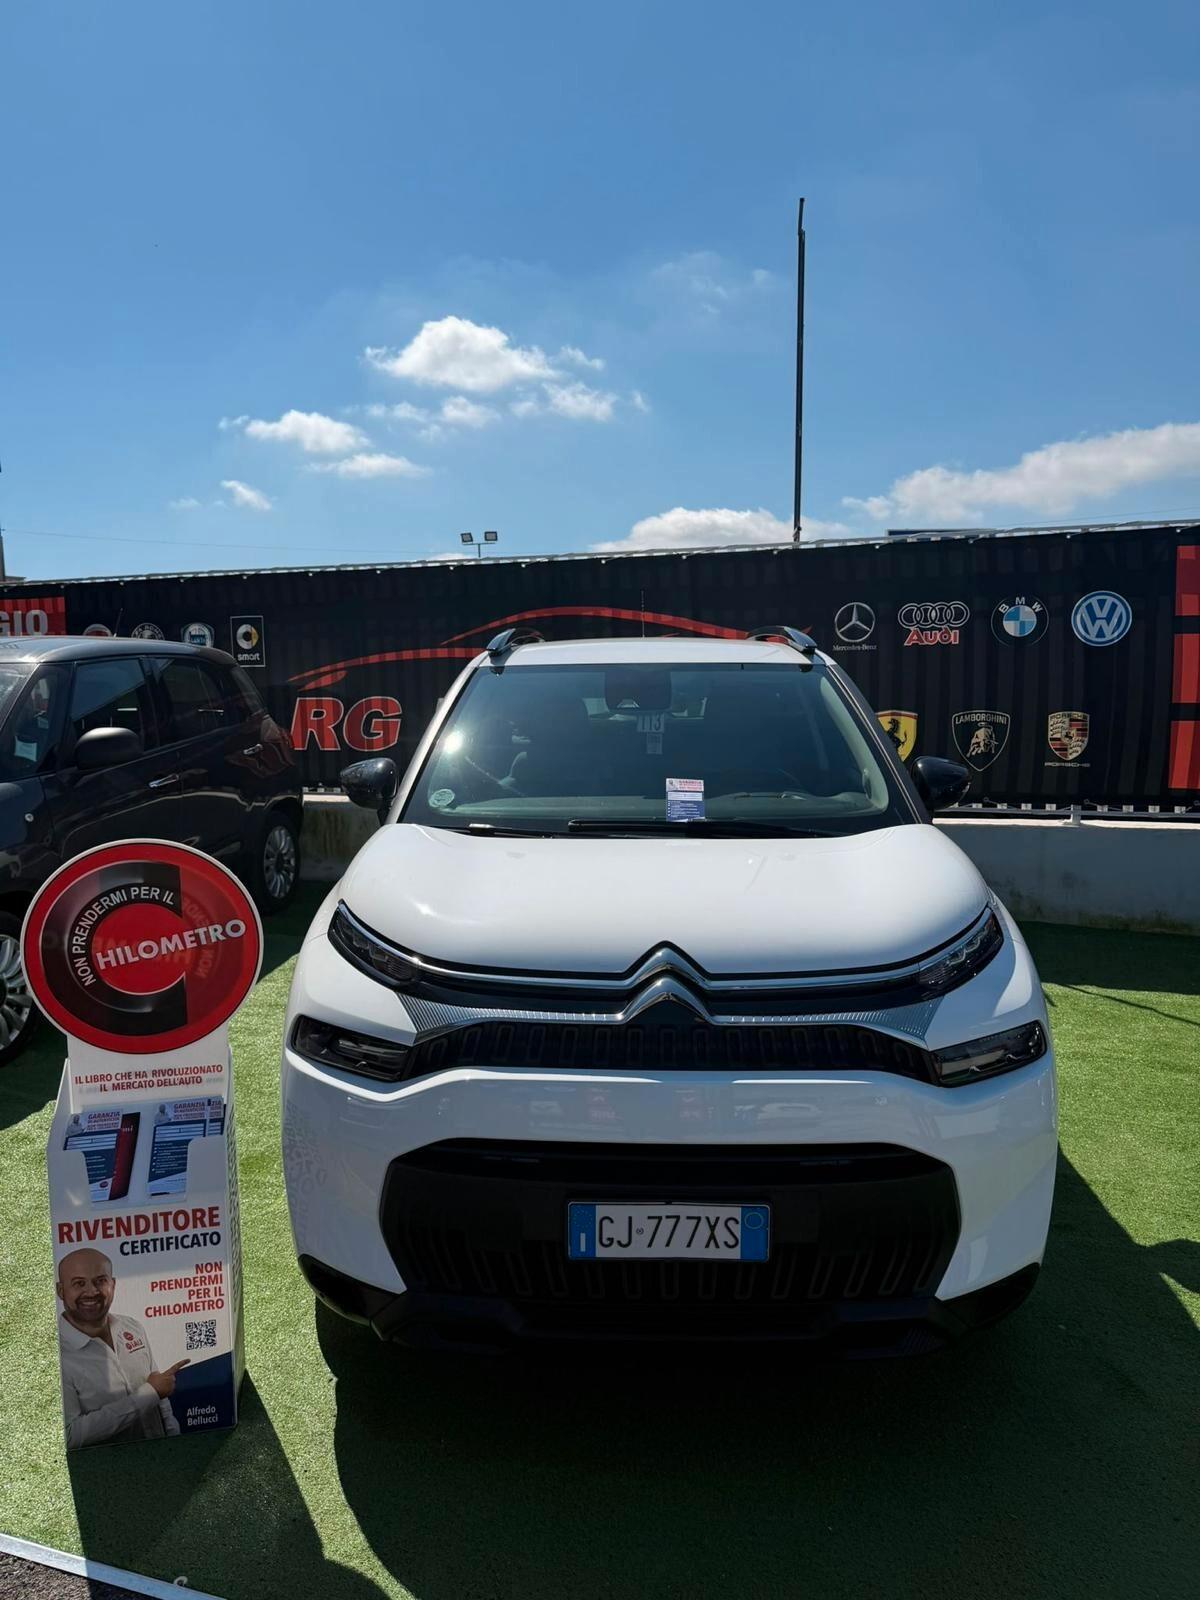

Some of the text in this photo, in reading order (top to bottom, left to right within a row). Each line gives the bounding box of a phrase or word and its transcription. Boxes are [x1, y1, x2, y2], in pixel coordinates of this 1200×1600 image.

[998, 596, 1043, 613] BMW
[904, 625, 960, 646] Audi
[832, 644, 877, 652] Mercedes-Benz
[237, 652, 260, 662] smart
[291, 696, 402, 752] RG
[955, 713, 1008, 725] LAMBORGHINI
[72, 886, 175, 987] NON PRENDERMI PER IL
[75, 1064, 223, 1085] IL LIBRO CHE HA RIVOLUZIONATO
[99, 1076, 203, 1093] IL MERCATO DELL'AUTO
[173, 1101, 206, 1110] GARANZIA
[87, 1111, 121, 1120] GARANZIA
[58, 1206, 221, 1244] RIVENDITORE
[119, 1231, 221, 1256] CERTIFICATO
[195, 1261, 223, 1275] NON
[150, 1274, 223, 1292] PRENDERMI
[188, 1286, 225, 1300] PER IL
[145, 1298, 224, 1318] CHILOMETRO
[187, 1405, 216, 1417] Alfredo
[187, 1413, 218, 1426] Bellucci
